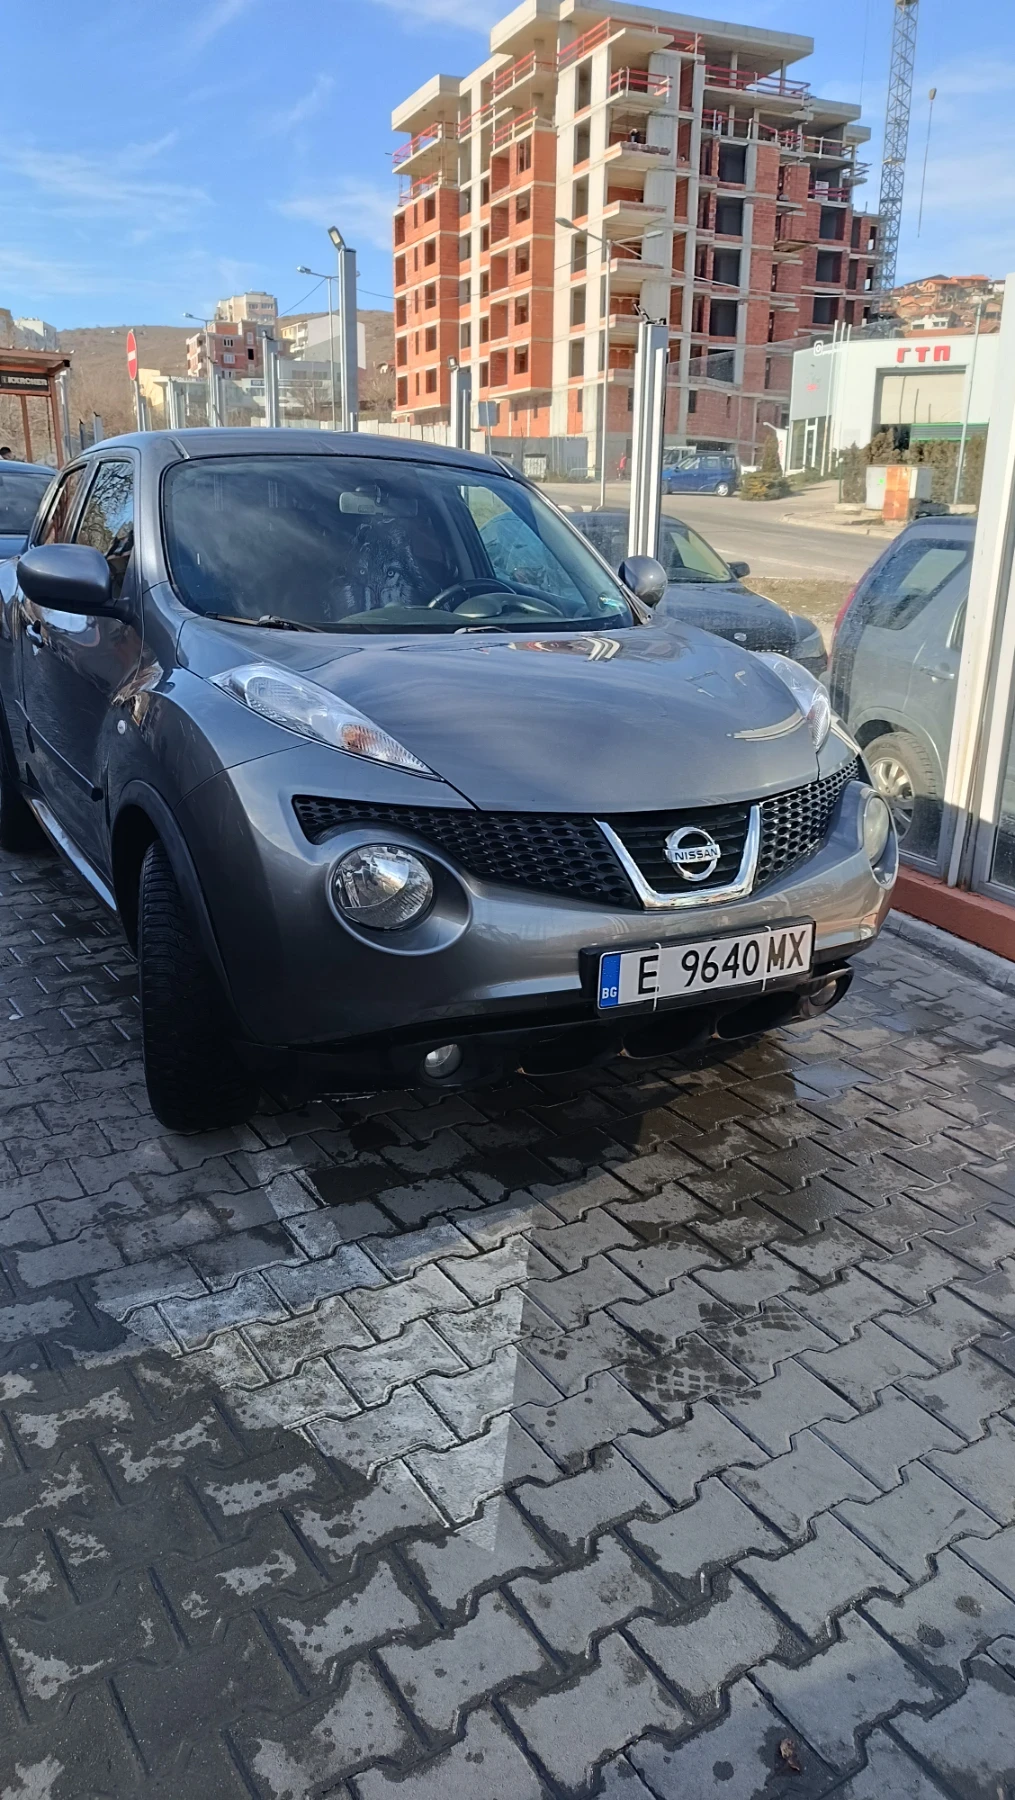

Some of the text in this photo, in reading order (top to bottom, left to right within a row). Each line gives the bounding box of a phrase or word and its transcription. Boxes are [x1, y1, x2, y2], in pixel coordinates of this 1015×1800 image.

[896, 346, 951, 363] ГТП
[674, 848, 718, 861] NISSAN
[638, 930, 806, 995] E 9640 MX
[601, 986, 618, 999] BG
